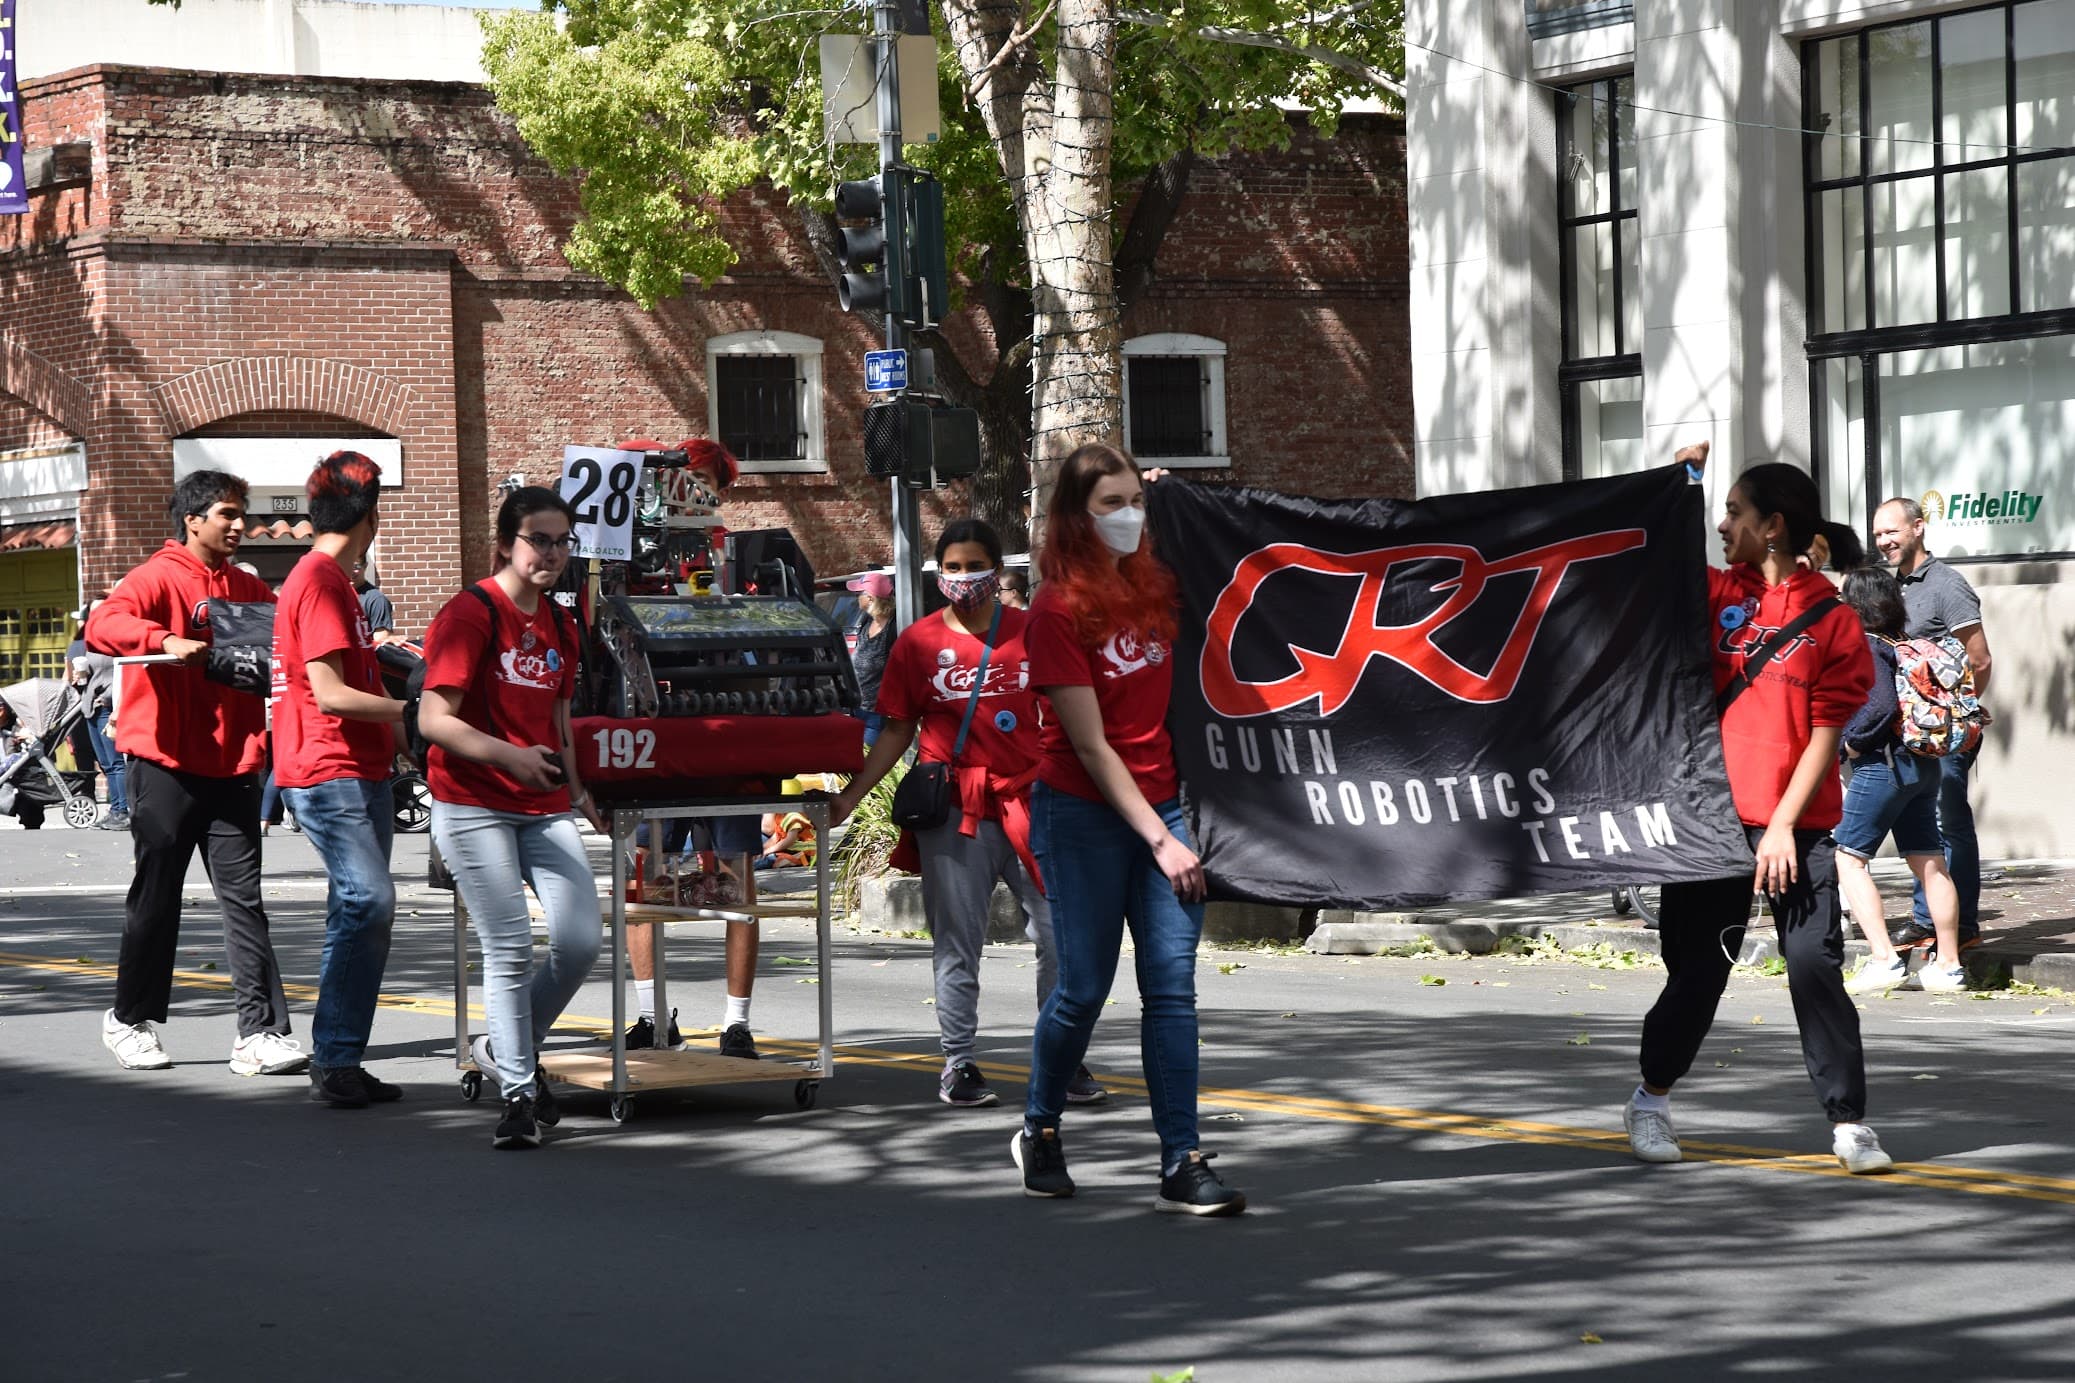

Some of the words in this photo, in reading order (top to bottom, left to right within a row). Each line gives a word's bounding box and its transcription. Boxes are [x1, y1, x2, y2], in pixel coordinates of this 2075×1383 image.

[275, 500, 294, 510] 235
[568, 458, 636, 528] 28
[1948, 491, 2043, 523] Fidelity
[1946, 517, 2024, 527] INVESTMENTS
[592, 728, 656, 769] 192
[1206, 722, 1338, 775] GUNN
[1304, 767, 1556, 826] ROBOTICS
[1521, 802, 1678, 863] TEAM
